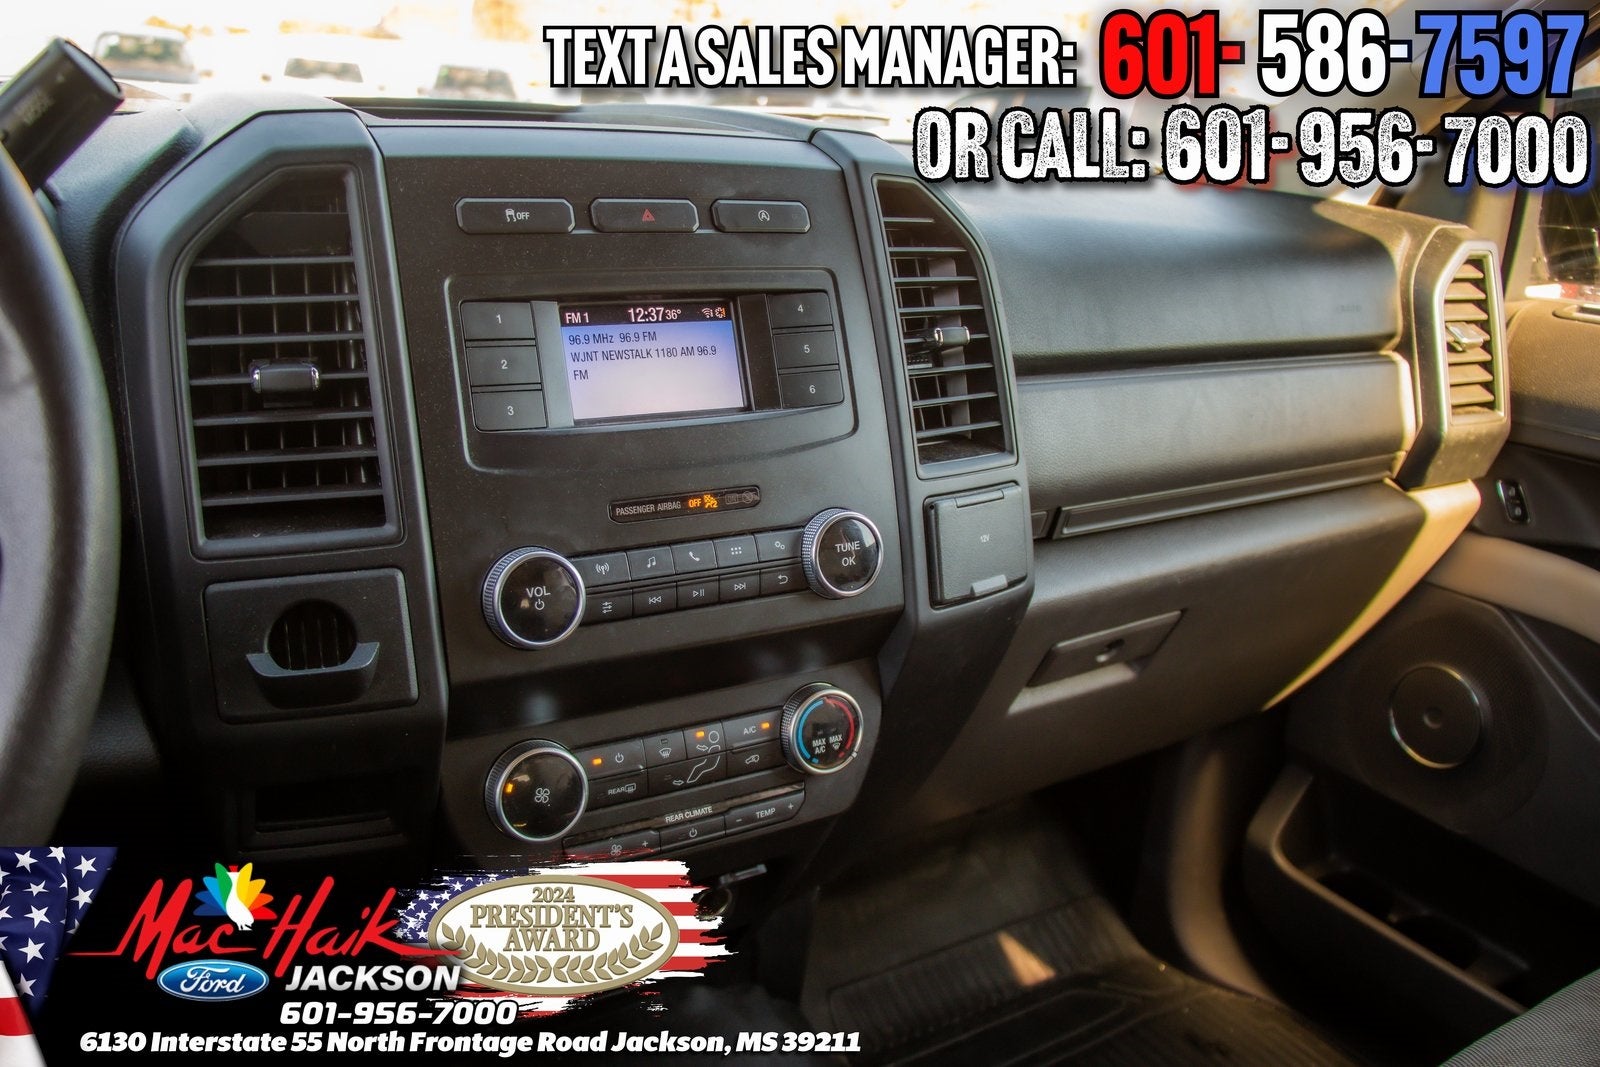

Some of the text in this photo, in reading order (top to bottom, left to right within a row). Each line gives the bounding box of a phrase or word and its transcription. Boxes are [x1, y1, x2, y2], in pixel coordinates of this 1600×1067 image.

[516, 211, 531, 221] OFF
[797, 304, 804, 313] 4
[495, 314, 502, 324] 1
[565, 307, 682, 324] FM 1 12:37 36°
[568, 331, 658, 345] 96.9 MHz 96.9 FM
[570, 345, 717, 362] WJNT NEWSTALK 1180 AM 96.9
[804, 344, 811, 354] 5
[500, 359, 508, 369] 2
[573, 369, 589, 381] FM
[808, 384, 816, 394] 6
[506, 405, 514, 415] 3
[615, 503, 656, 516] PASSENGER
[657, 501, 682, 511] AIRBAG
[688, 499, 702, 508] OFF
[834, 540, 861, 553] TUNE
[841, 555, 856, 567] OK
[525, 586, 551, 599] VOL
[743, 726, 757, 735] A/C
[812, 738, 826, 748] MAX
[829, 734, 843, 744] MAX
[814, 745, 826, 754] A/C
[607, 787, 625, 796] REAR
[665, 805, 713, 823] REAR CLIMATE
[755, 807, 776, 819] TEMP
